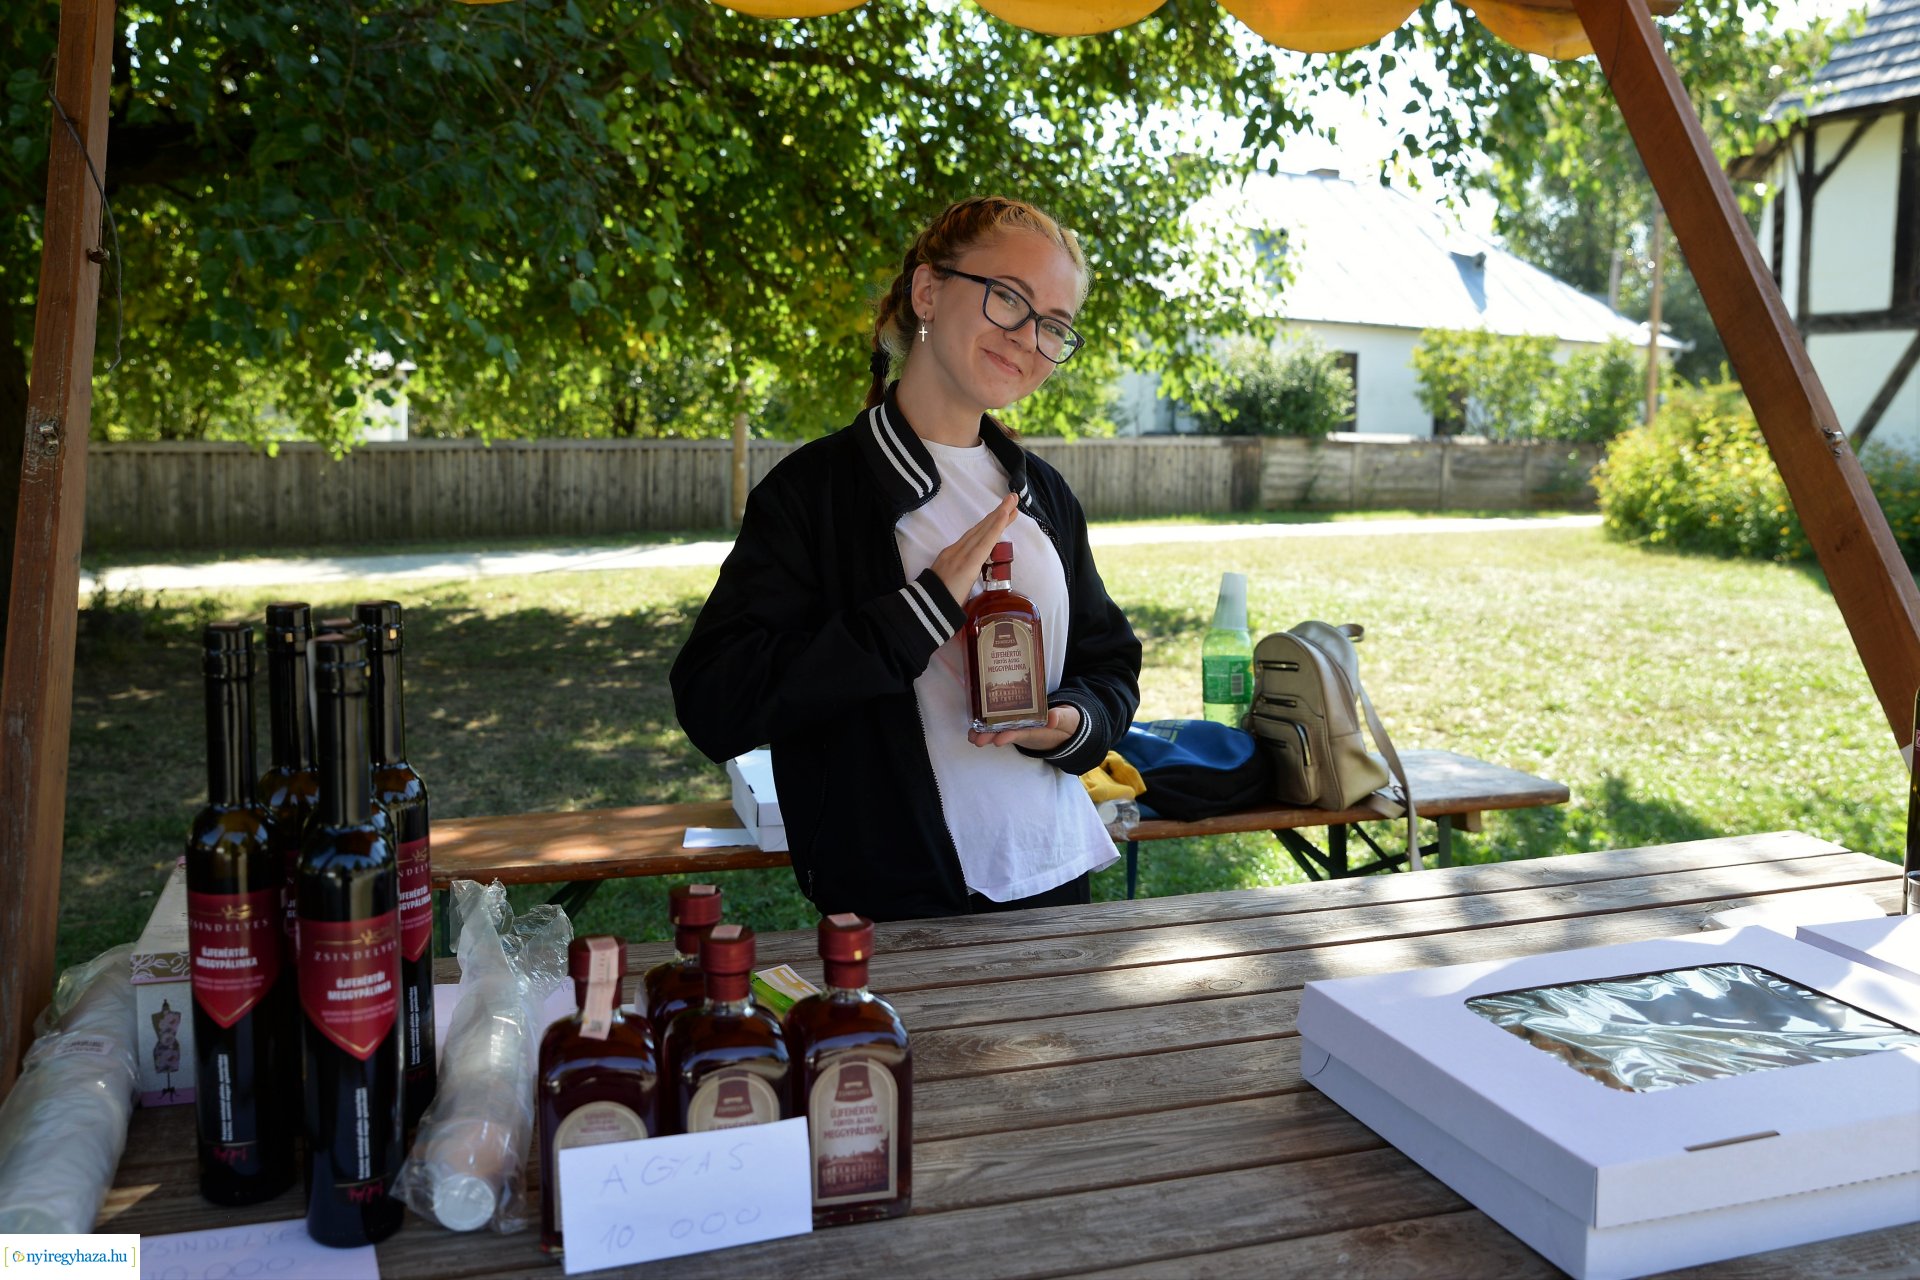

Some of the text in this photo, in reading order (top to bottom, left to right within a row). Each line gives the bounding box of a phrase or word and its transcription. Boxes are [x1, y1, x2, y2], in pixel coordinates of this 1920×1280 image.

[399, 885, 429, 901] JFEHÉRTÓI
[399, 893, 432, 911] GGYPÁLINKA
[600, 1223, 635, 1254] 10
